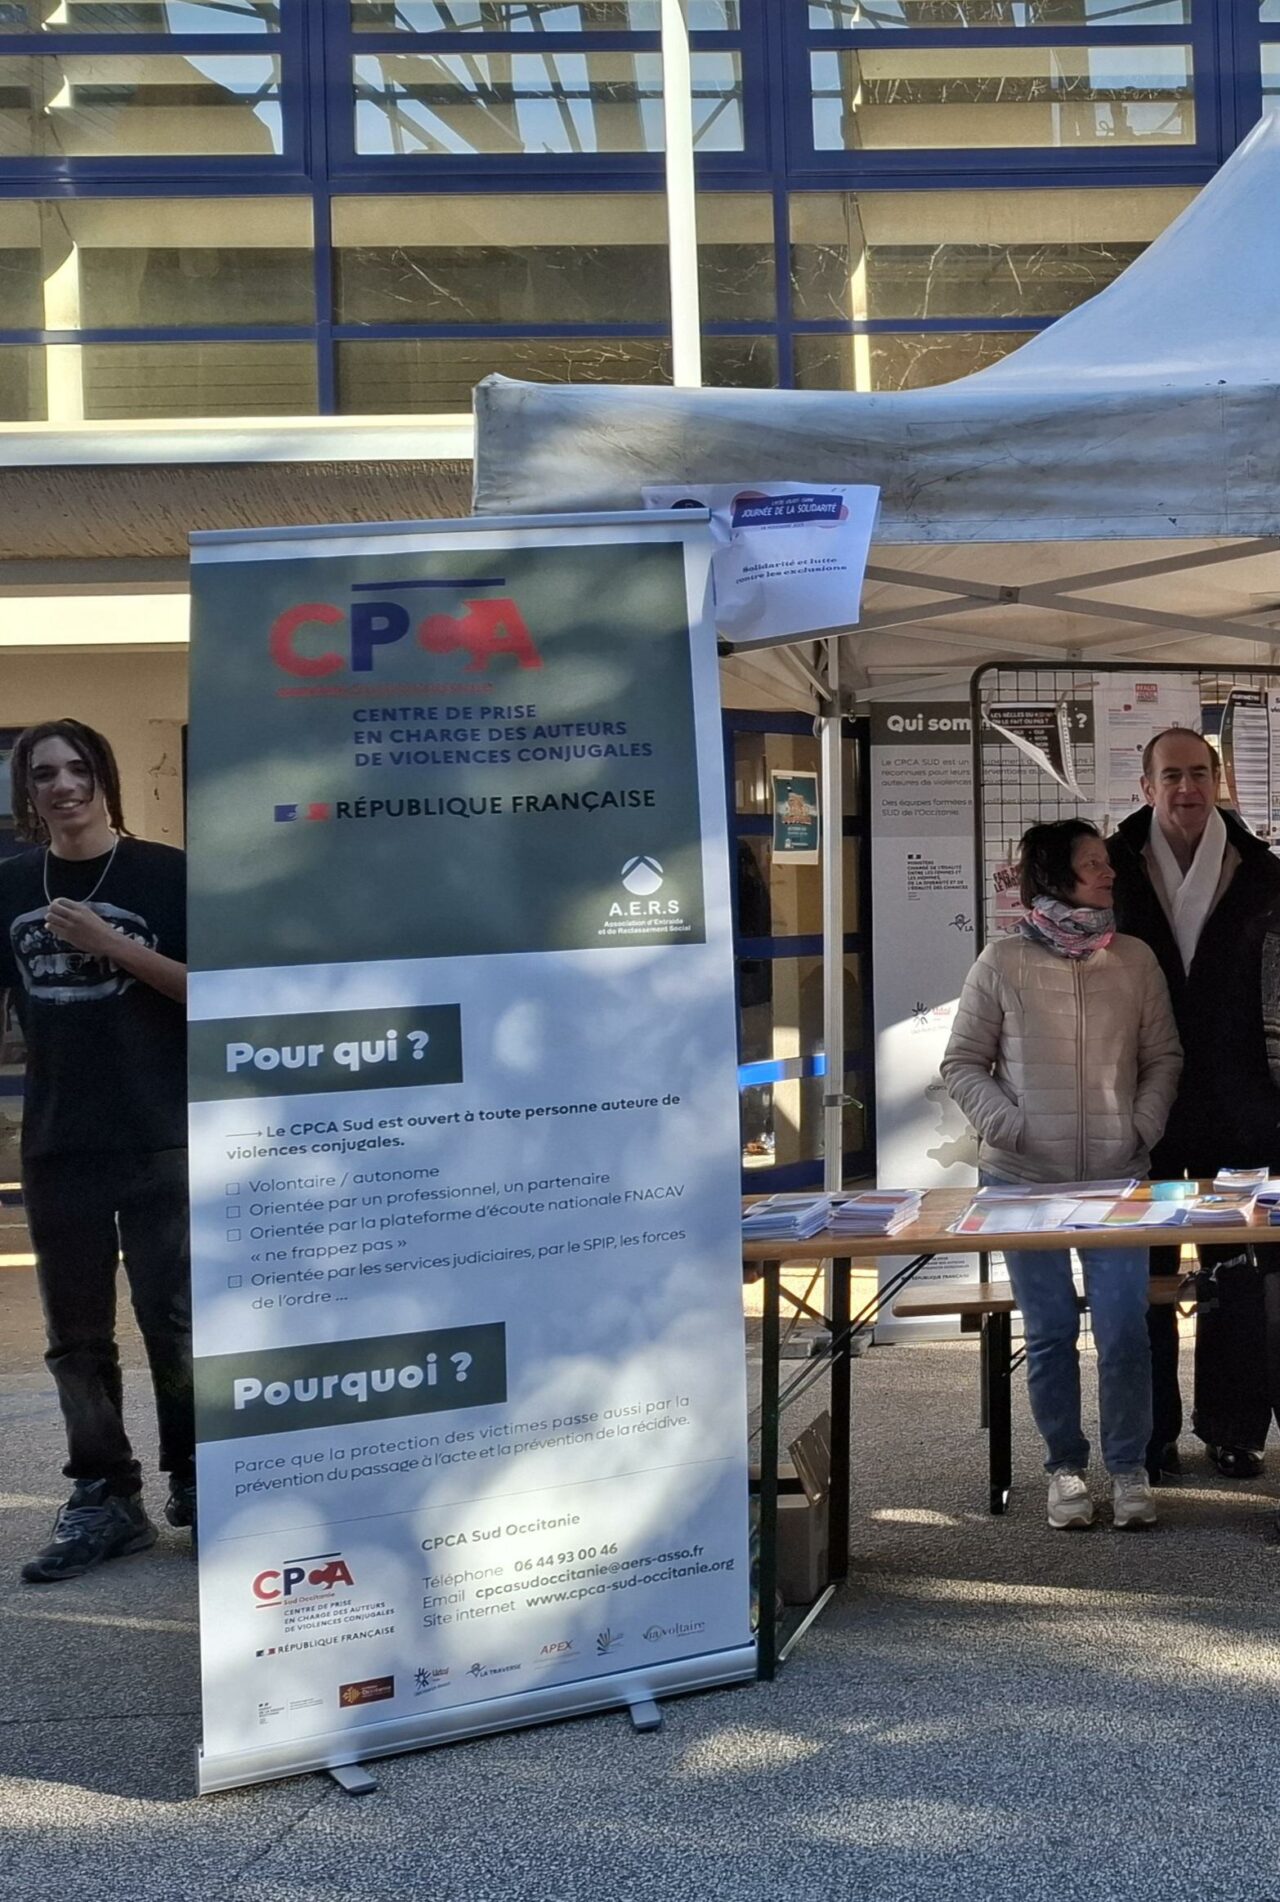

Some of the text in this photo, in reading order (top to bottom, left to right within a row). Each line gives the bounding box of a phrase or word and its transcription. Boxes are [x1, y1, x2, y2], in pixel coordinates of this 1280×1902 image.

[775, 506, 784, 515] DE
[797, 503, 837, 513] SOLIDARITÉ
[353, 704, 536, 722] CENTRE DE PRISE
[887, 714, 972, 732] Qui som
[354, 722, 627, 744] EN CHARGE DES AUTEURS
[355, 743, 653, 766] DE VIOLENCES CONJUGALES
[336, 789, 655, 819] RÉPUBLIQUE FRANÇAISE
[609, 900, 679, 916] A.E.R.S
[226, 1029, 429, 1072] Pour qui ?
[267, 1094, 680, 1138] Le CPCA Sud est ouvert à toute personne auteure de
[227, 1136, 405, 1160] violences conjugales.
[249, 1168, 440, 1193] Volontaire / autonome
[250, 1172, 610, 1216] Orientée par un professionnel, un partenaire
[234, 1352, 472, 1410] Pourquoi ?
[422, 1514, 580, 1551] CPCA Sud Occitanie
[423, 1543, 618, 1589] Téléphone 06 44 93 00 46
[424, 1544, 704, 1609] Email cpcasudoccitanie@aers-asso.fr
[424, 1558, 734, 1628] Site internet www.cpca-sud-occitanie.org
[278, 1626, 395, 1654] RÉPUBLIQUE FRANÇAISE
[540, 1640, 573, 1655] APEX
